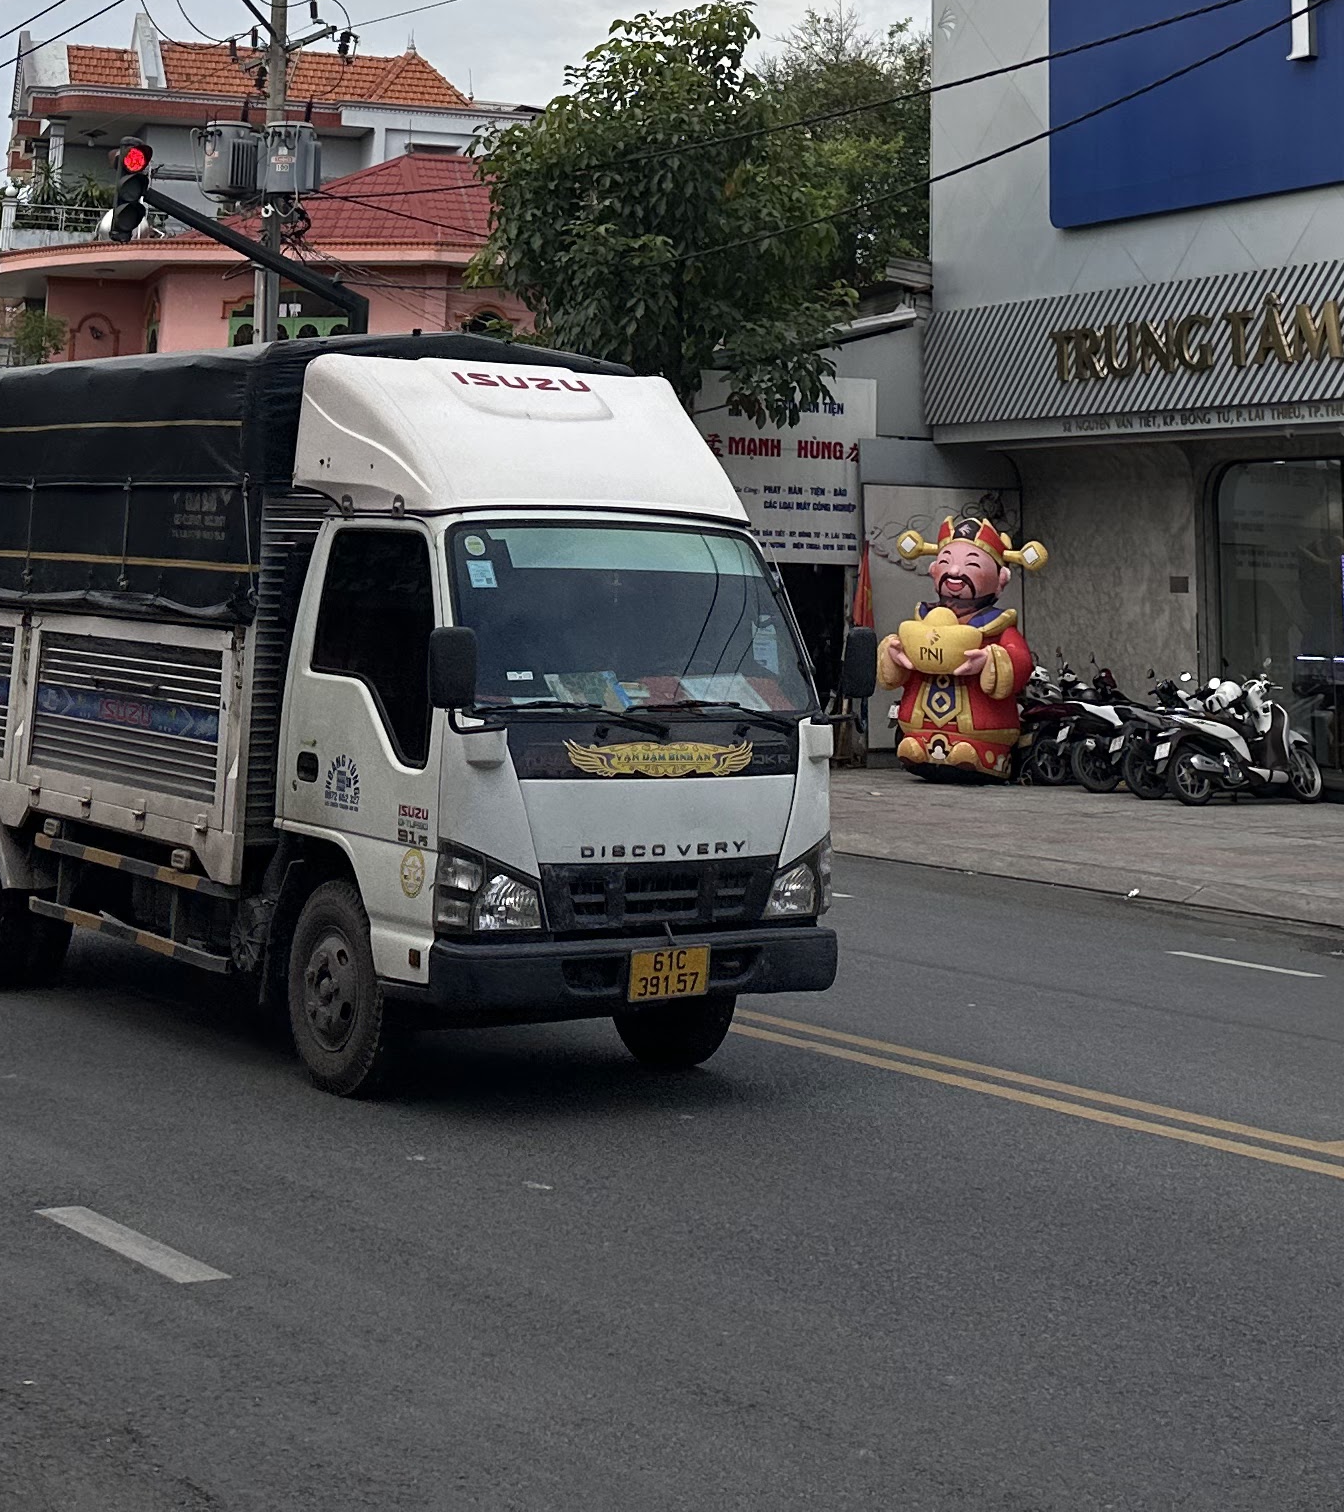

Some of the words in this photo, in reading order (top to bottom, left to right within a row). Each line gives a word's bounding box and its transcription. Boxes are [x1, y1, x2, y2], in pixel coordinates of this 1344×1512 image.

[1050, 311, 1214, 382] TRUNG
[1222, 290, 1344, 366] TÂM
[451, 371, 592, 393] ISUZU
[728, 436, 782, 460] MẠNH
[796, 435, 844, 460] HÙNG
[919, 646, 944, 665] PNJ
[99, 698, 153, 728] ISUZU
[398, 804, 429, 820] ISUZU
[398, 828, 416, 845] 91
[653, 950, 687, 972] 61C
[637, 971, 700, 997] 391.57
